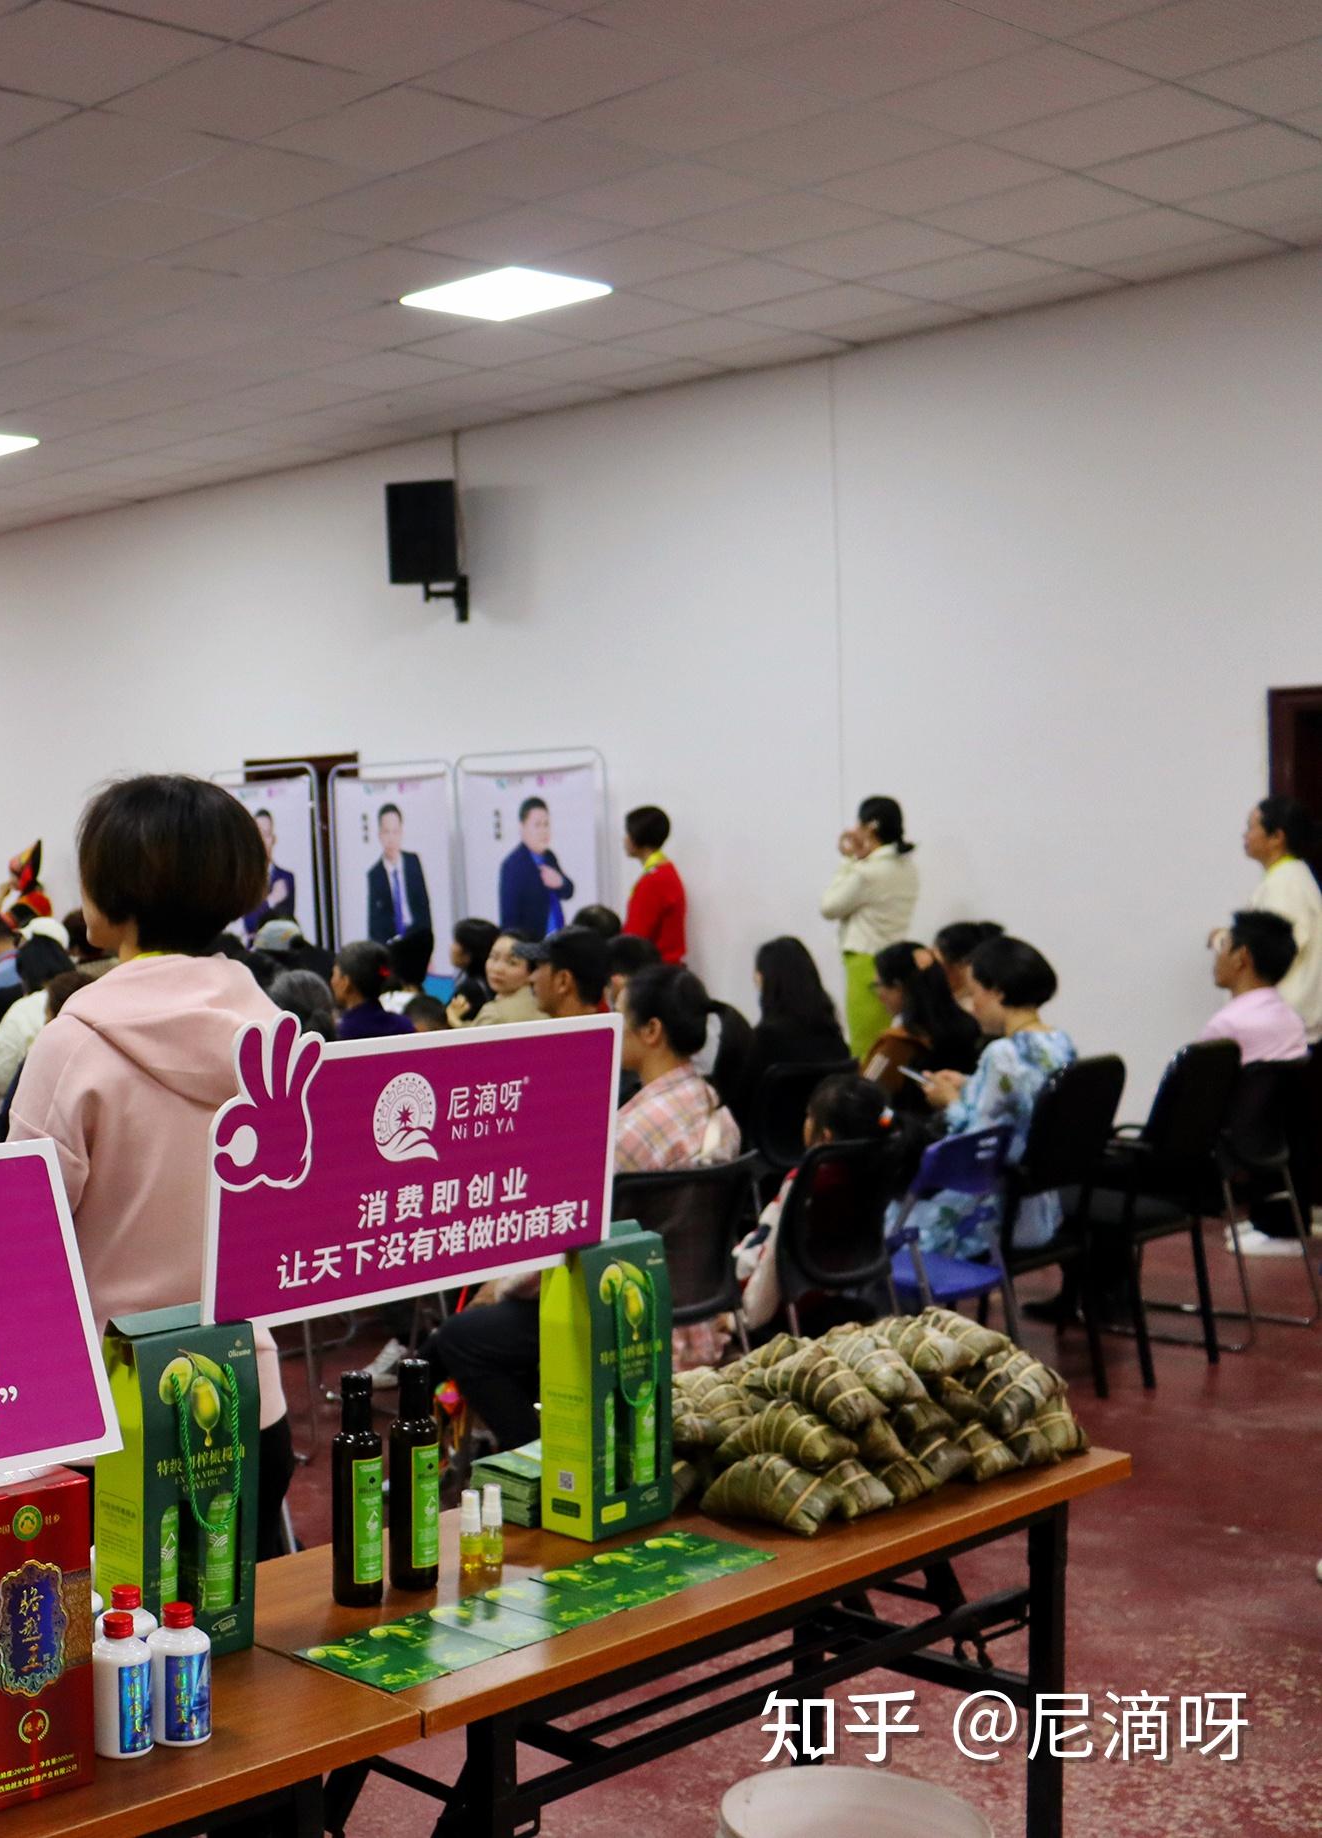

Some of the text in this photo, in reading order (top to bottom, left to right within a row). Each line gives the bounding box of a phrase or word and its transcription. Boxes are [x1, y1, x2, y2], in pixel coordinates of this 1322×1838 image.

[447, 1080, 522, 1120] 尼滴呀
[451, 1123, 468, 1140] Ni
[474, 1120, 489, 1138] Di
[358, 1167, 528, 1230] 消费即创业
[277, 1200, 589, 1290] 让天下没有难做的商家!
